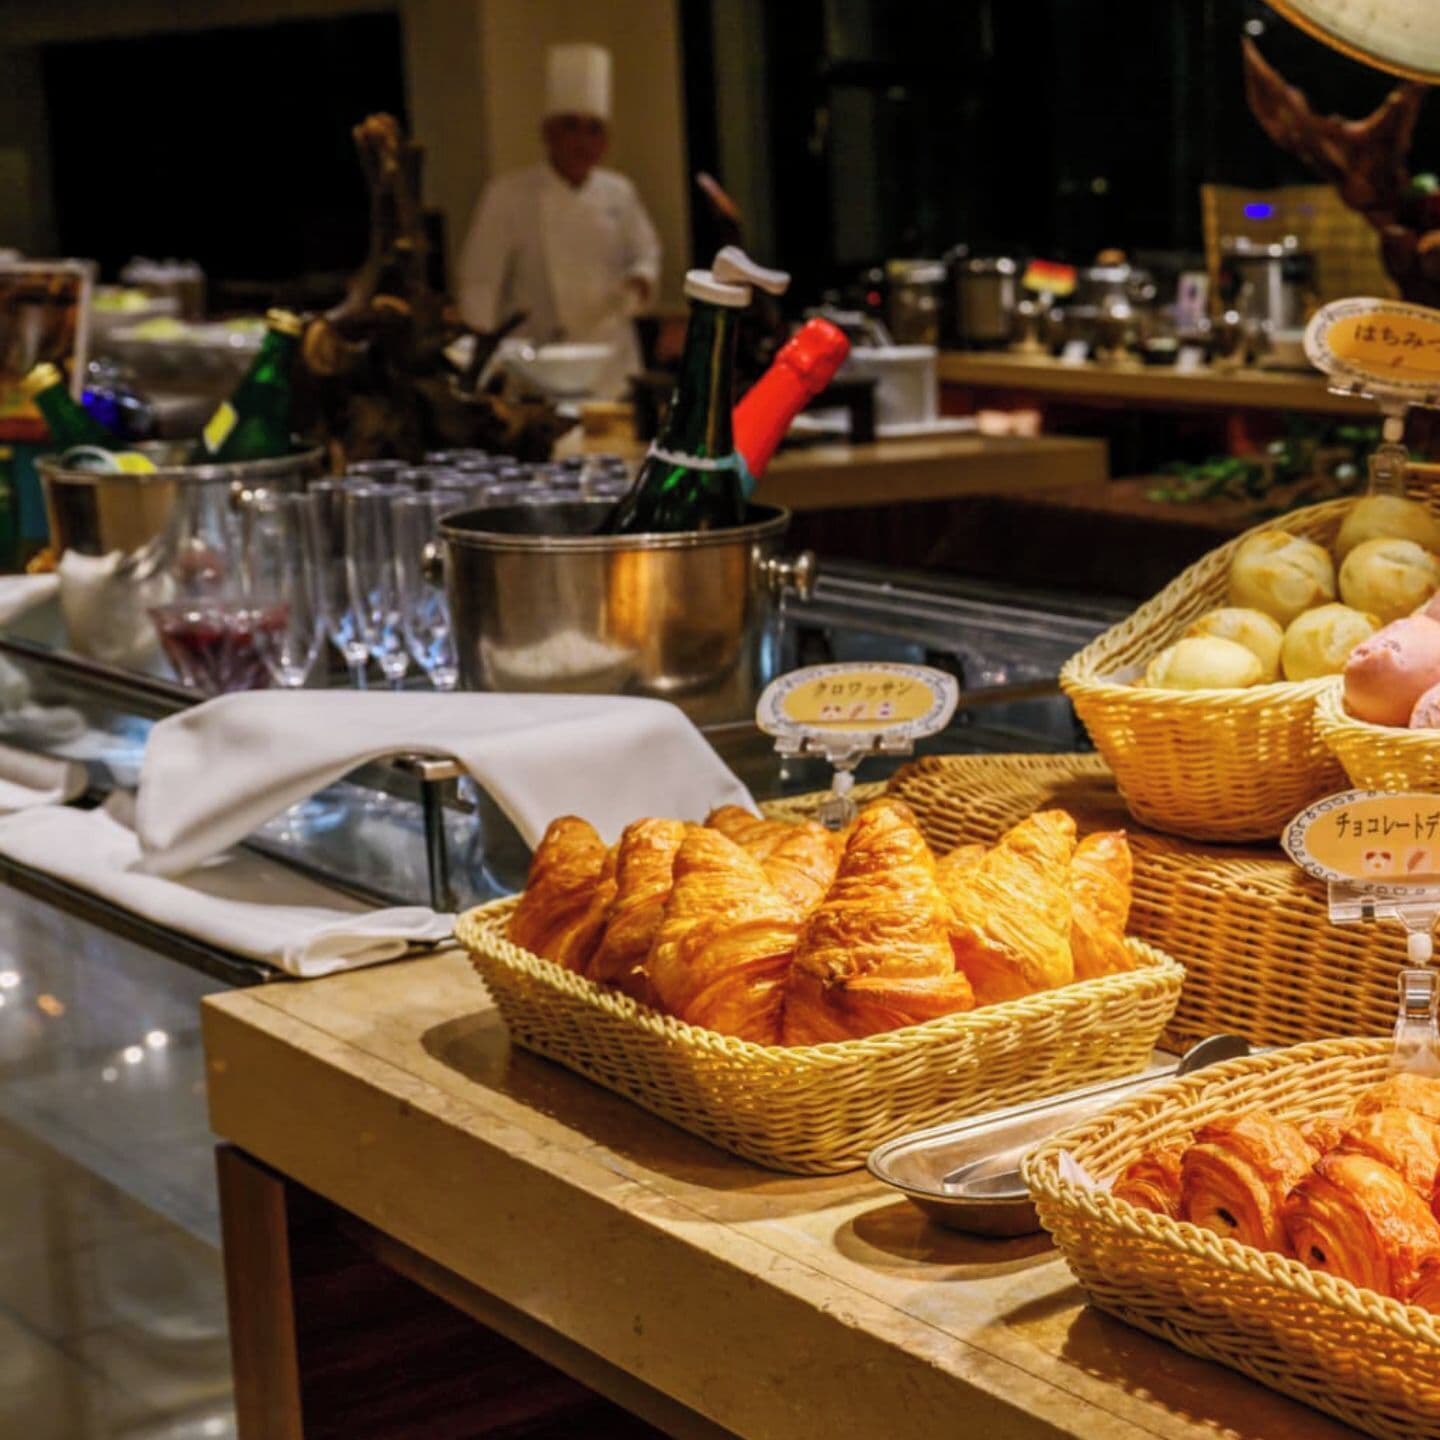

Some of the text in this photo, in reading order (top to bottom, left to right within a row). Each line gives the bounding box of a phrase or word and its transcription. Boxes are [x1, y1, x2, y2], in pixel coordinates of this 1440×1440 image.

[813, 680, 913, 698] クロワッサン
